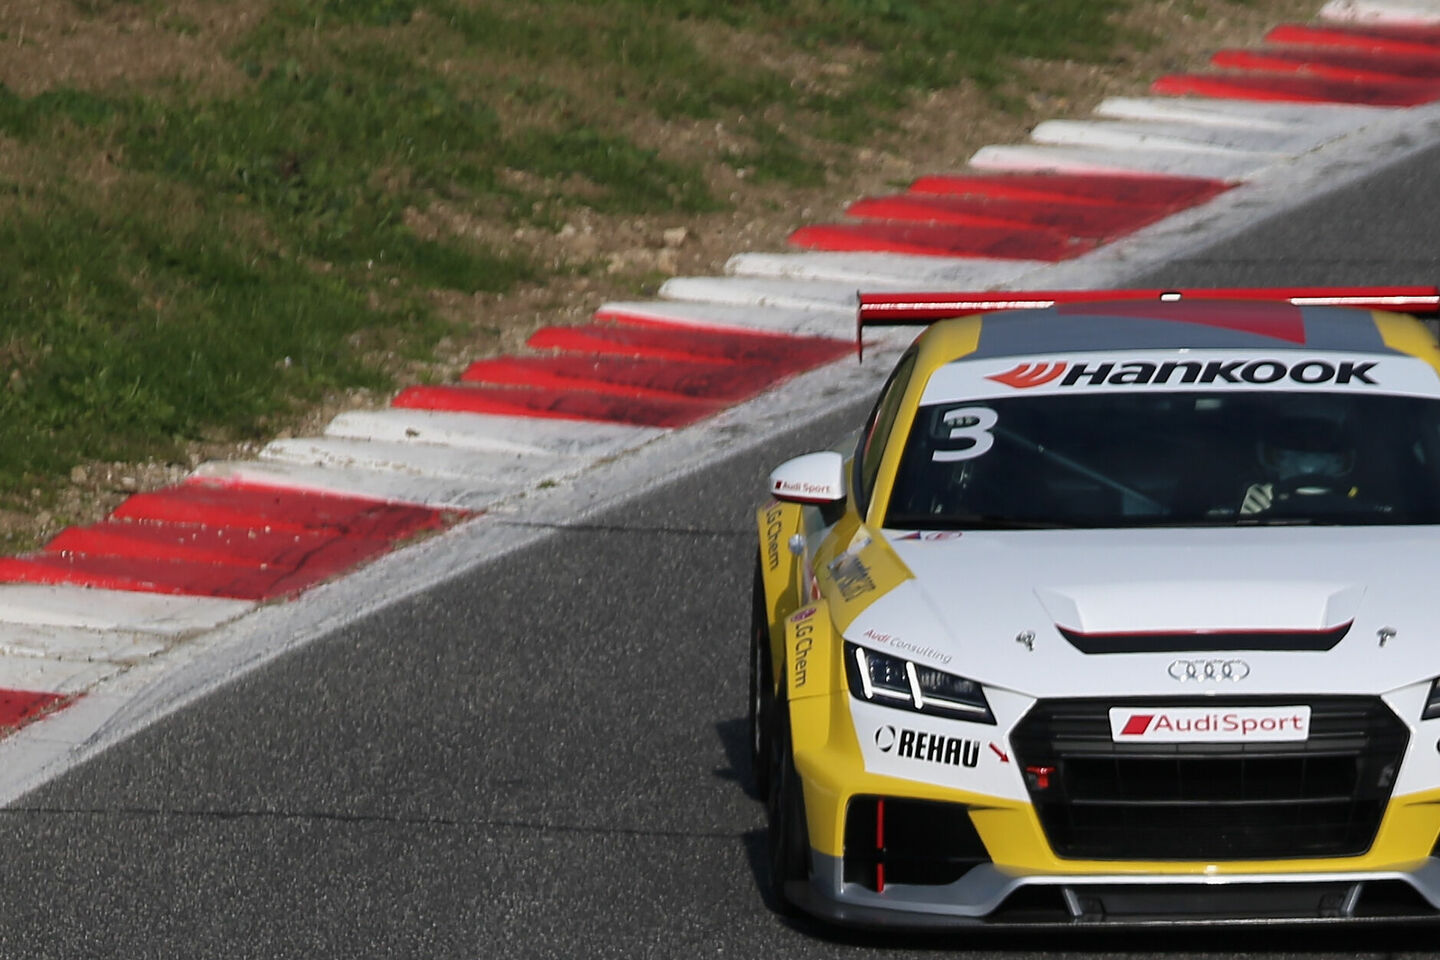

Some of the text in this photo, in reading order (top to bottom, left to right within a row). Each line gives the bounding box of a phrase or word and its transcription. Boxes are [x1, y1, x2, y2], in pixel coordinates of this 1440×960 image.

[931, 406, 999, 462] 3
[782, 480, 831, 494] Audi Sport
[795, 636, 813, 689] Chem
[863, 628, 953, 665] Audi Consulting
[1153, 713, 1304, 735] Audi Sport
[897, 727, 980, 769] REHAU
